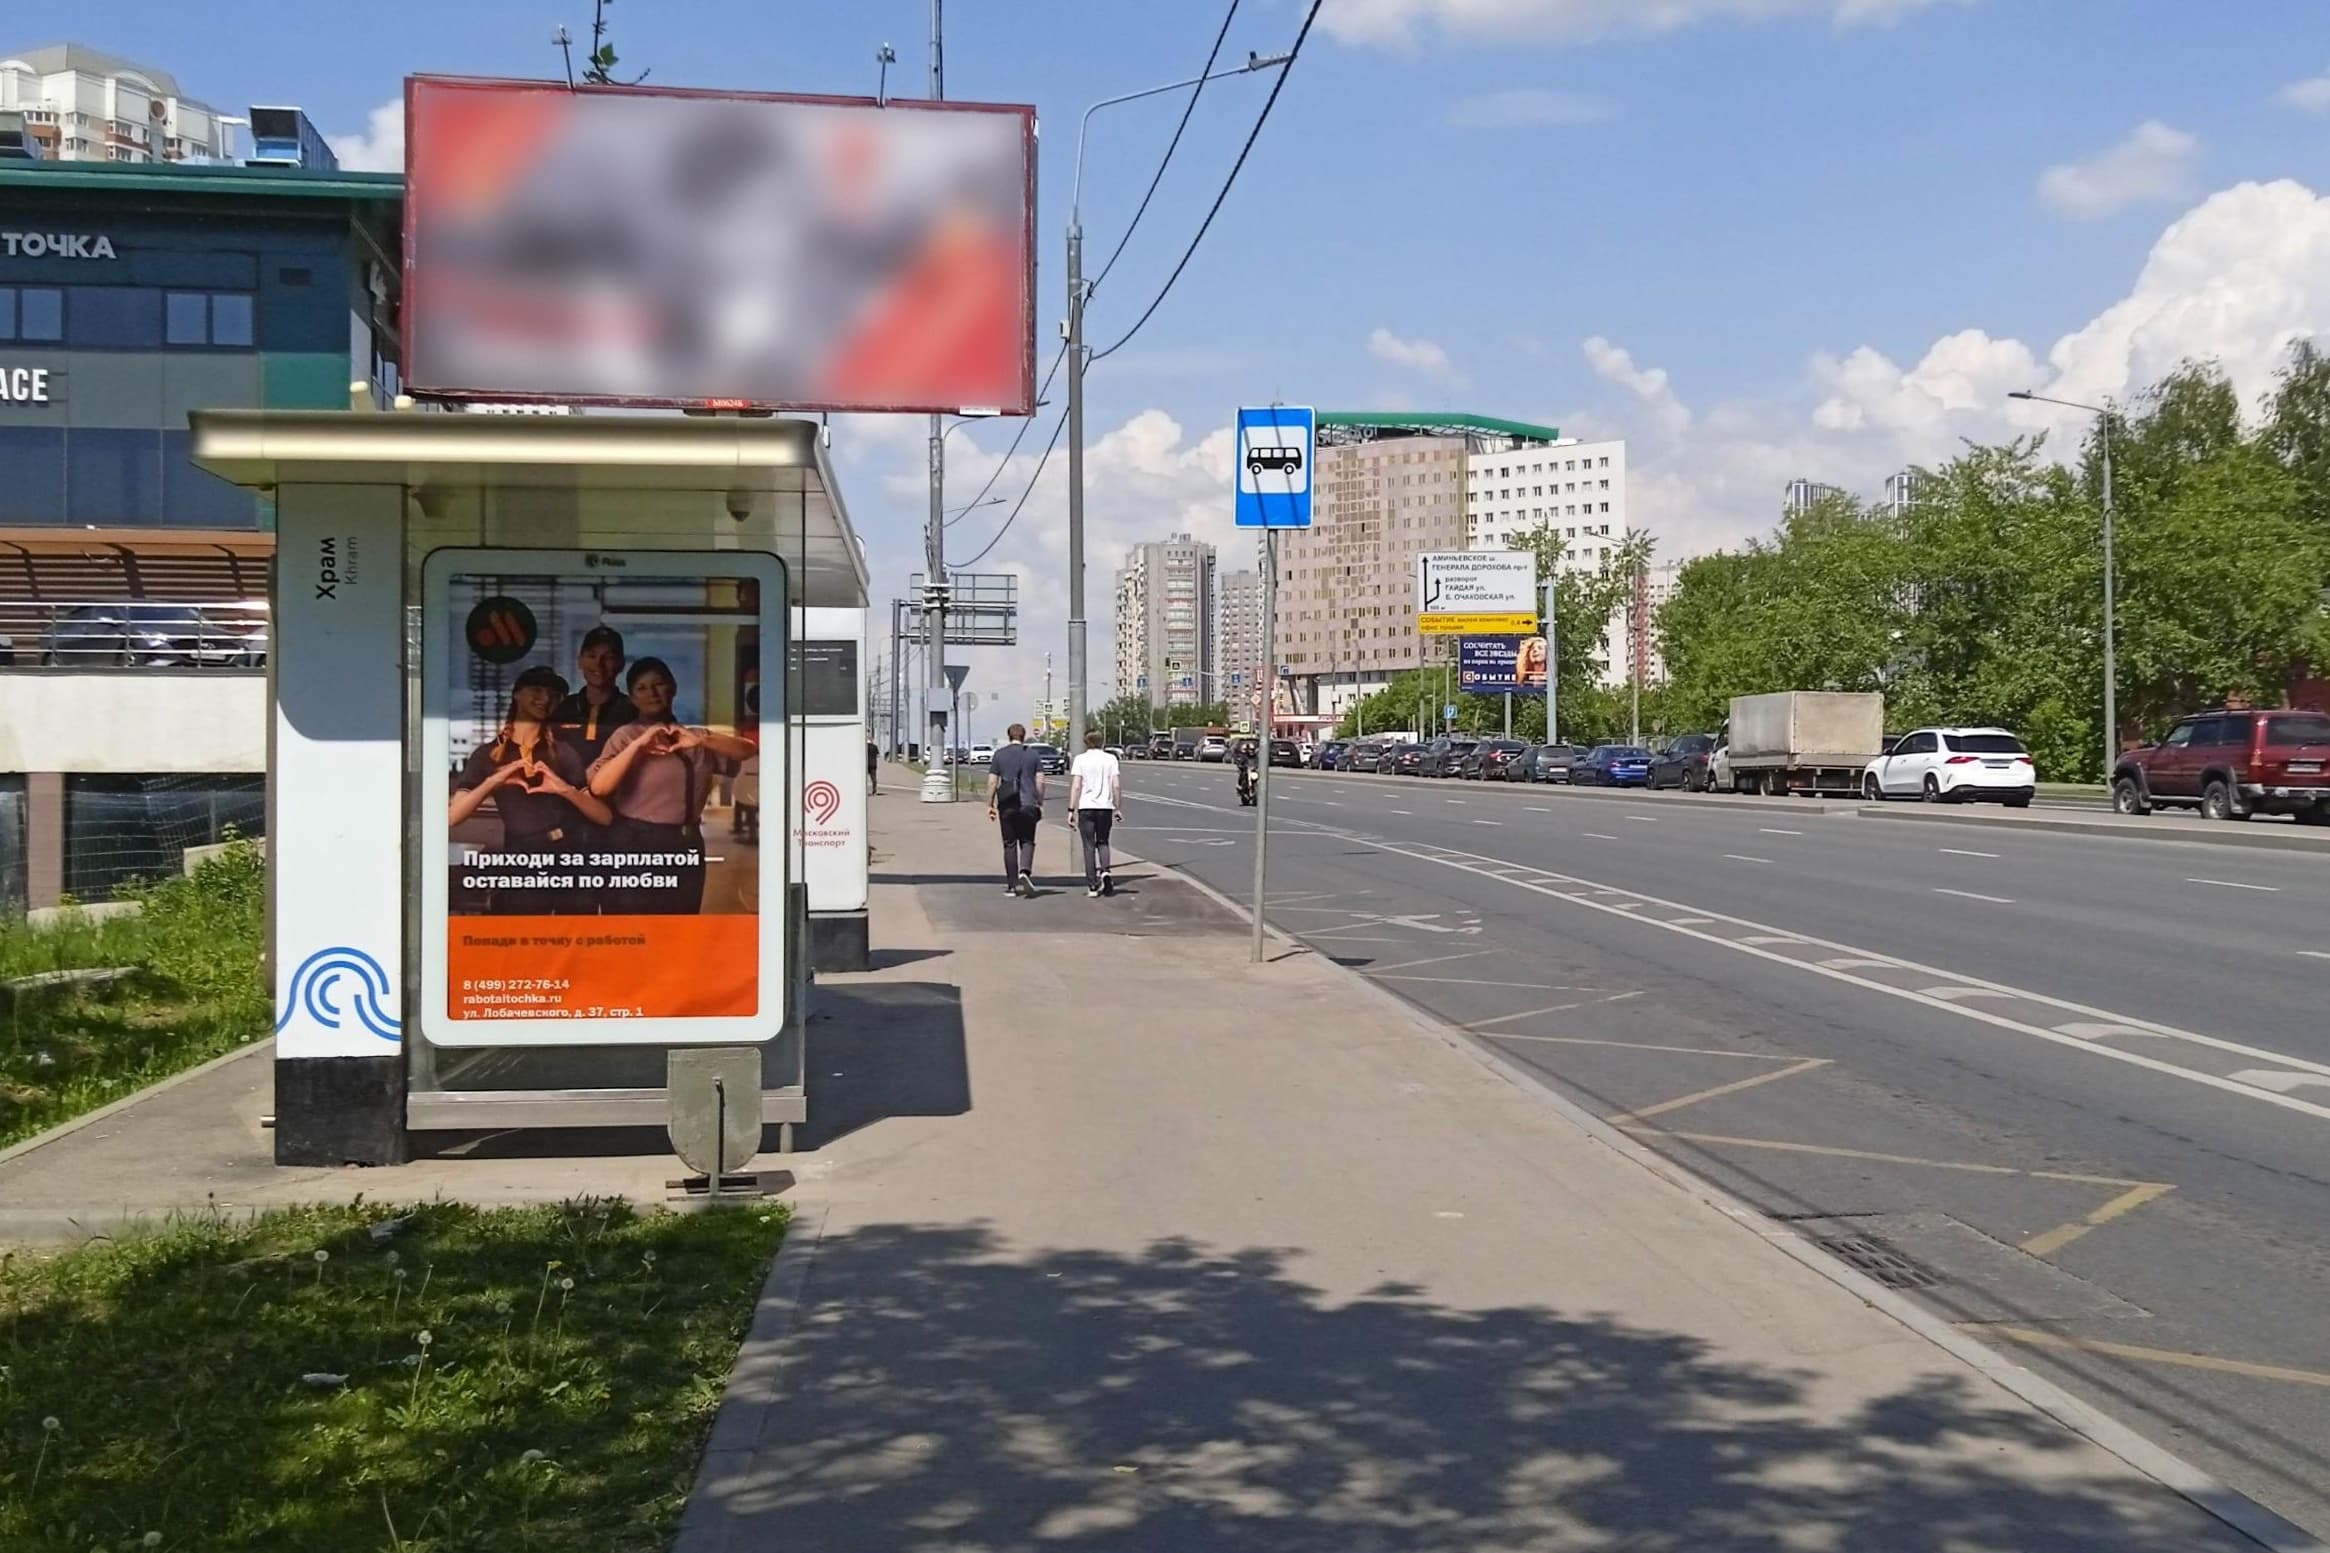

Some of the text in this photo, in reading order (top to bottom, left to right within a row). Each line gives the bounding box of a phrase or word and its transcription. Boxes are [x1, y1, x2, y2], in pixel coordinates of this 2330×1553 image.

[1, 232, 117, 259] ТОЧКА
[344, 536, 358, 584] Khram
[315, 537, 340, 600] Храм
[1464, 673, 1516, 681] СОБЫТИЕ
[463, 850, 555, 869] Приходи
[559, 854, 584, 866] за
[589, 849, 700, 869] зарплатой
[463, 871, 678, 888] оставайся по любви
[463, 935, 646, 948] Попади в точку с работой
[463, 979, 570, 991] 8 (499) 272-76-14
[463, 993, 562, 1004] rabotaitochka.ru
[463, 1007, 644, 1019] ул. Лобачевского, д. 37, стр. 1
